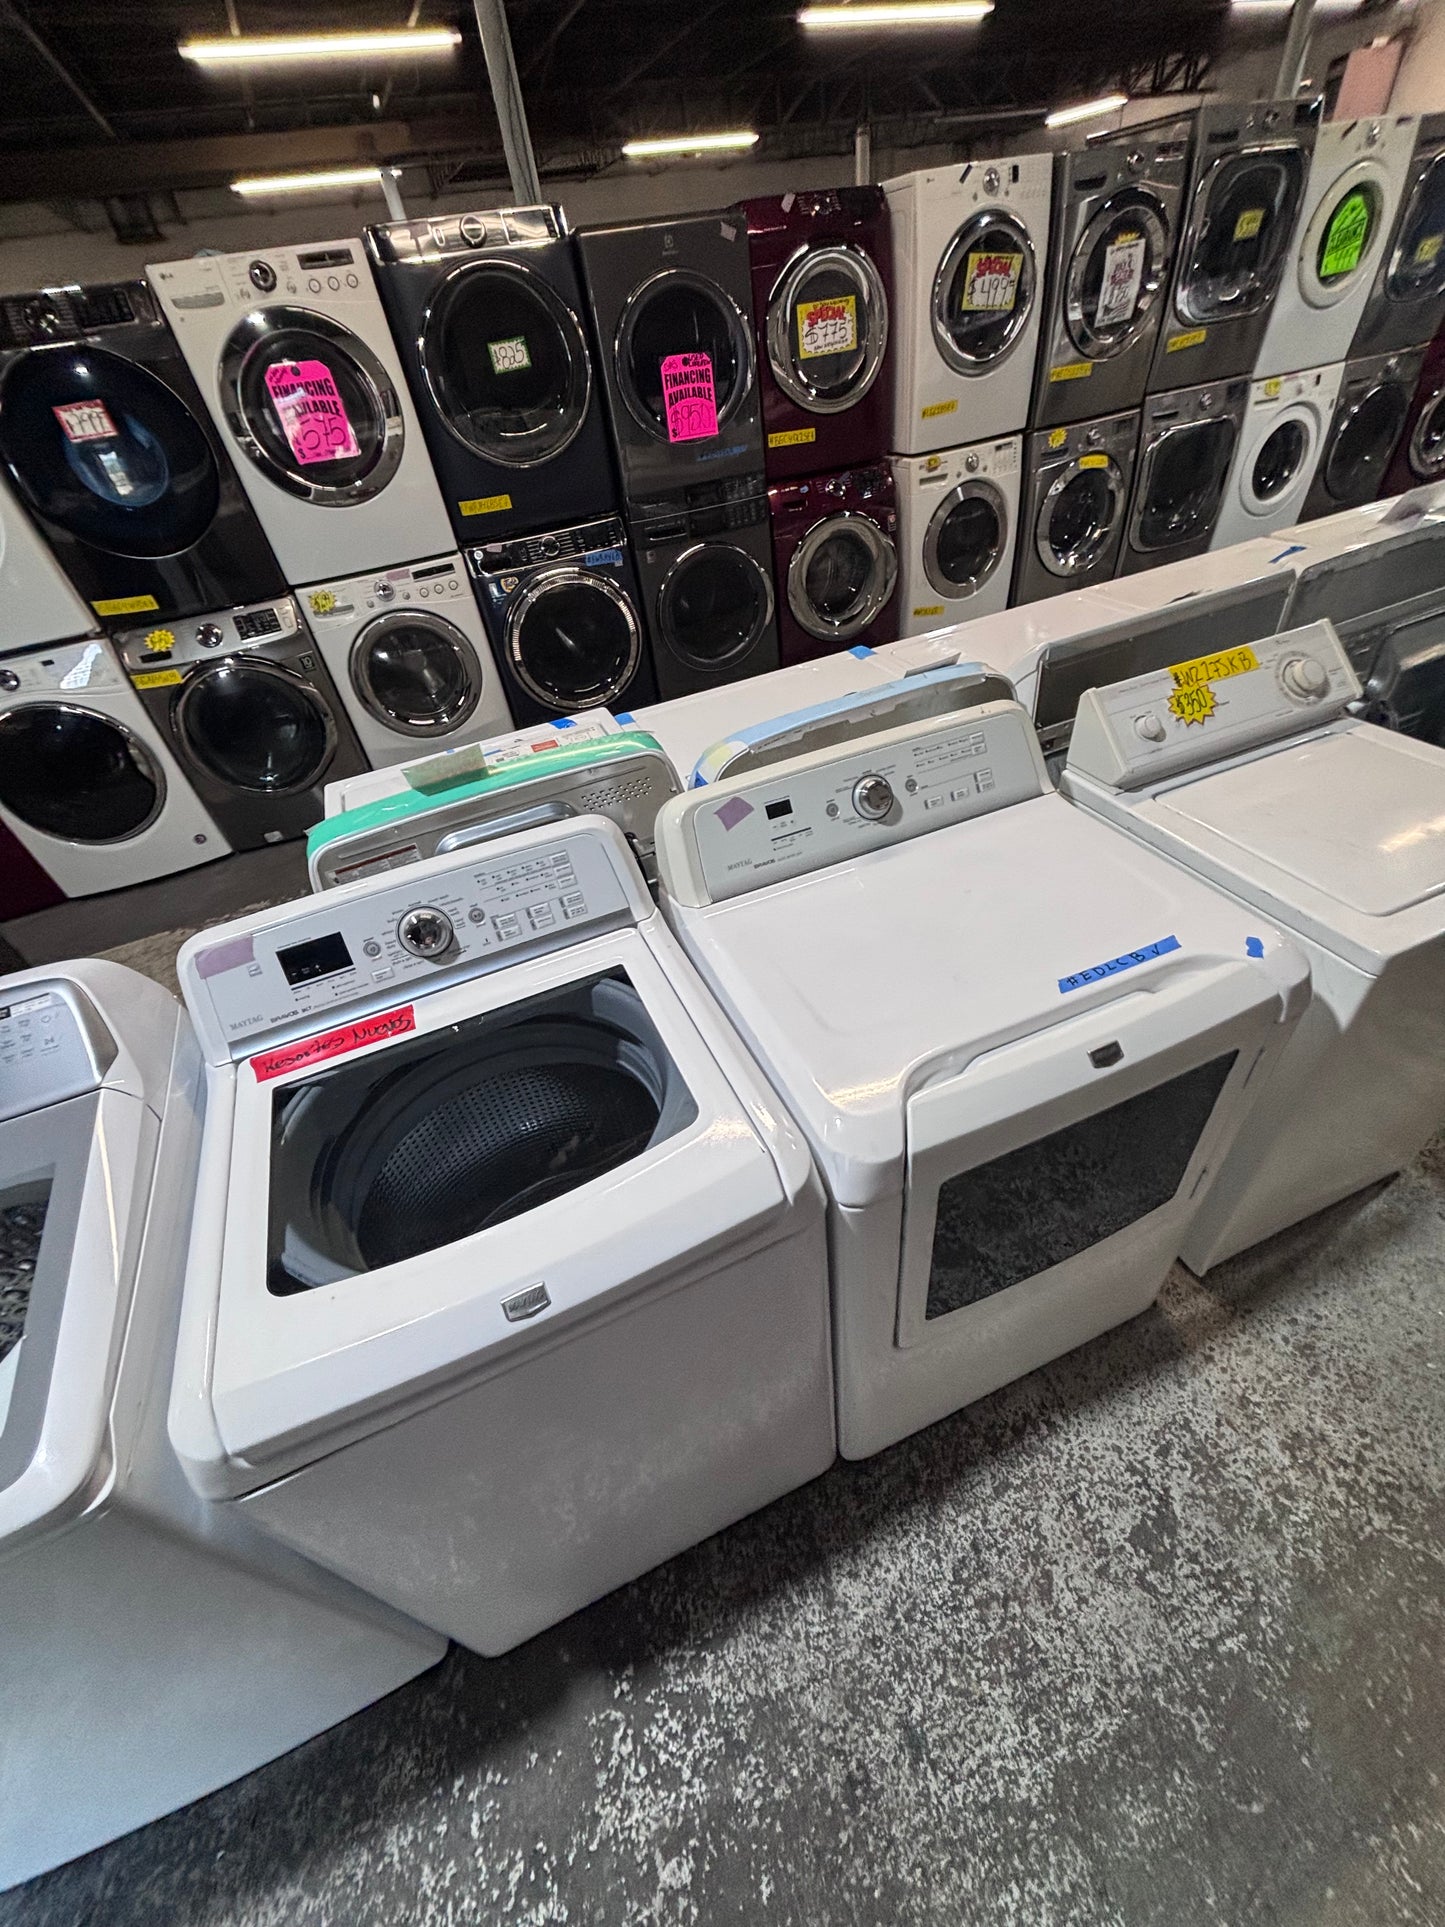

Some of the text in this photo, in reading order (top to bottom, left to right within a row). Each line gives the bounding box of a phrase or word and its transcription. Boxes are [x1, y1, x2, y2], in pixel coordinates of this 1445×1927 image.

[805, 321, 848, 345] $775
[664, 368, 711, 391] FINANCING
[668, 386, 714, 411] AVAILABLE
[229, 1014, 264, 1031] MAYTAG
